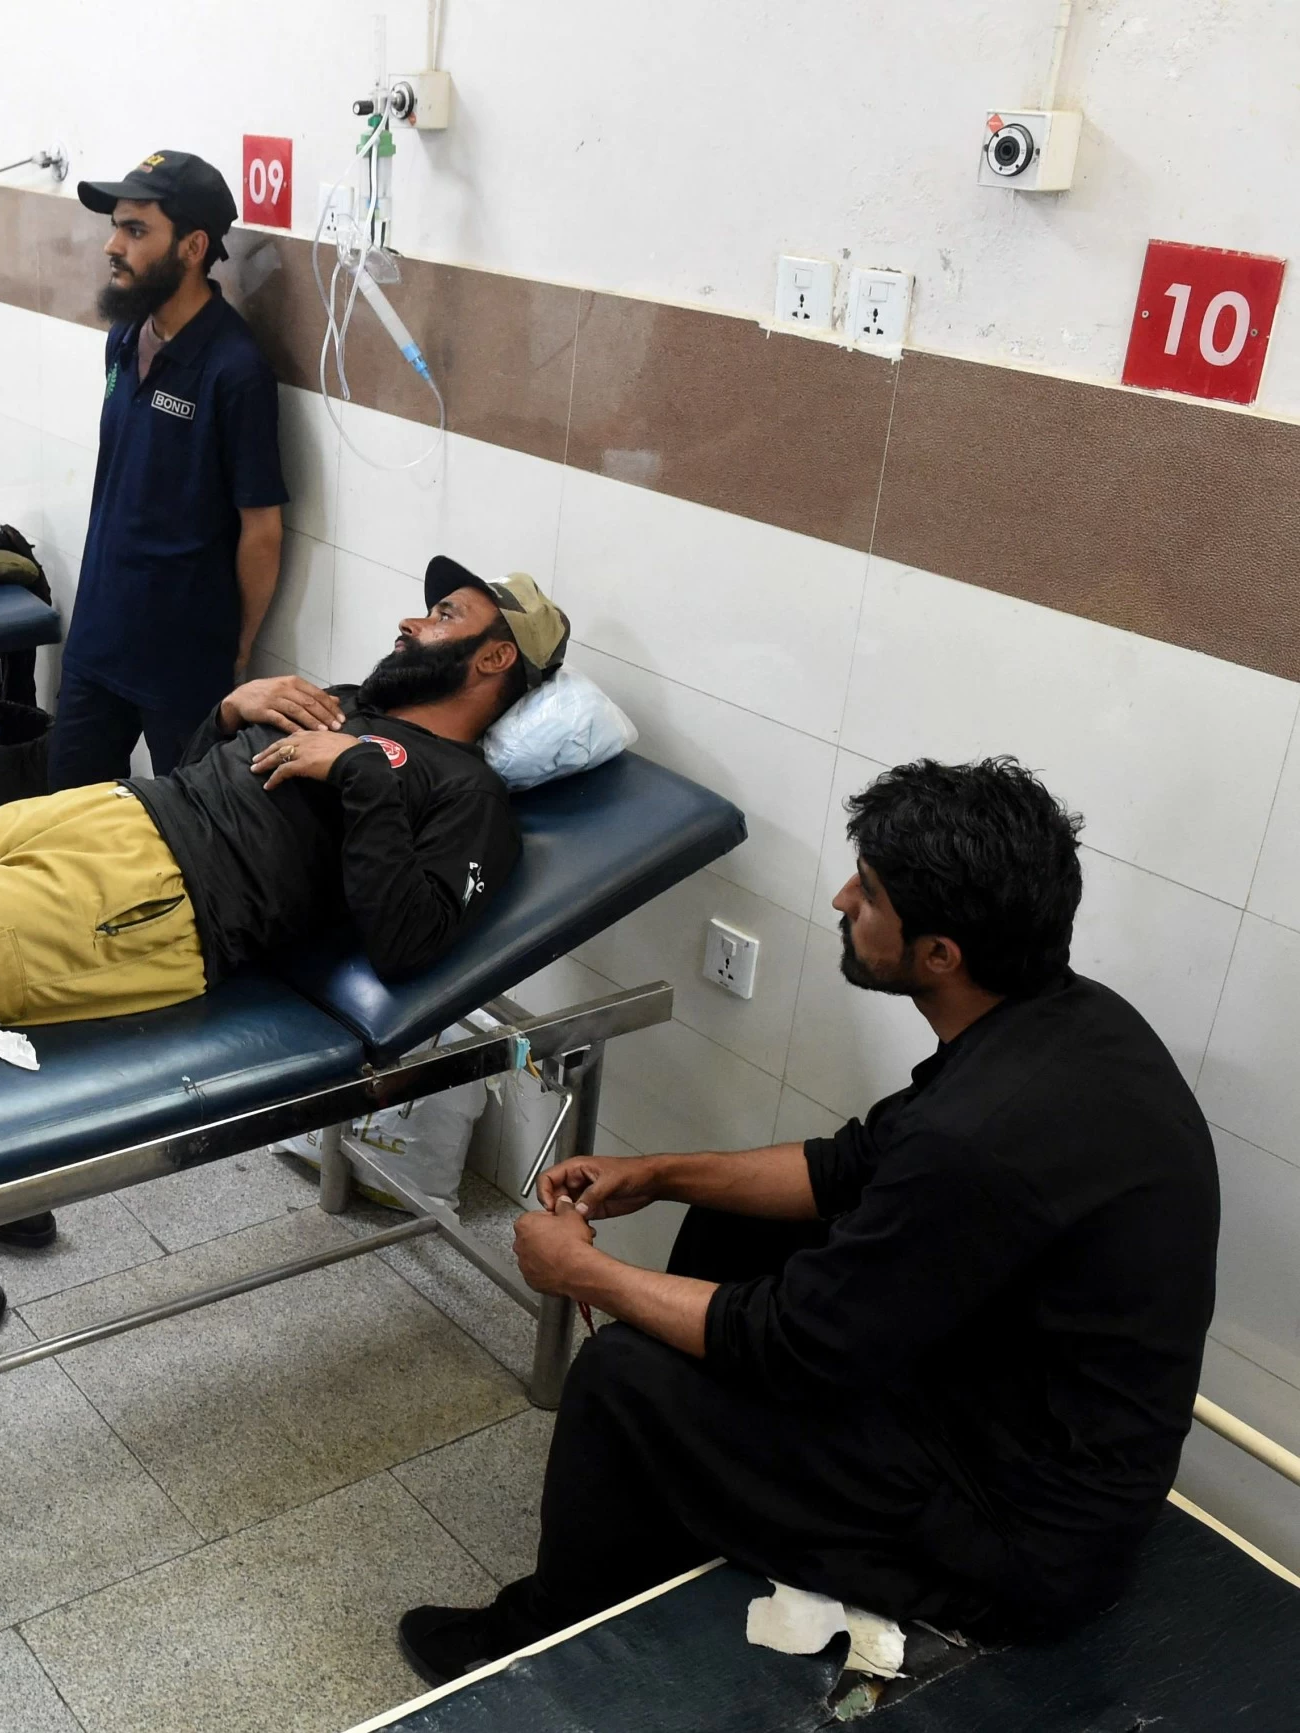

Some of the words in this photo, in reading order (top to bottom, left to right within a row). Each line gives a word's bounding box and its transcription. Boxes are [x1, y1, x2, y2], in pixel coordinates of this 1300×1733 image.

[249, 158, 284, 206] 09
[1163, 282, 1251, 367] 10
[155, 394, 191, 416] BOND
